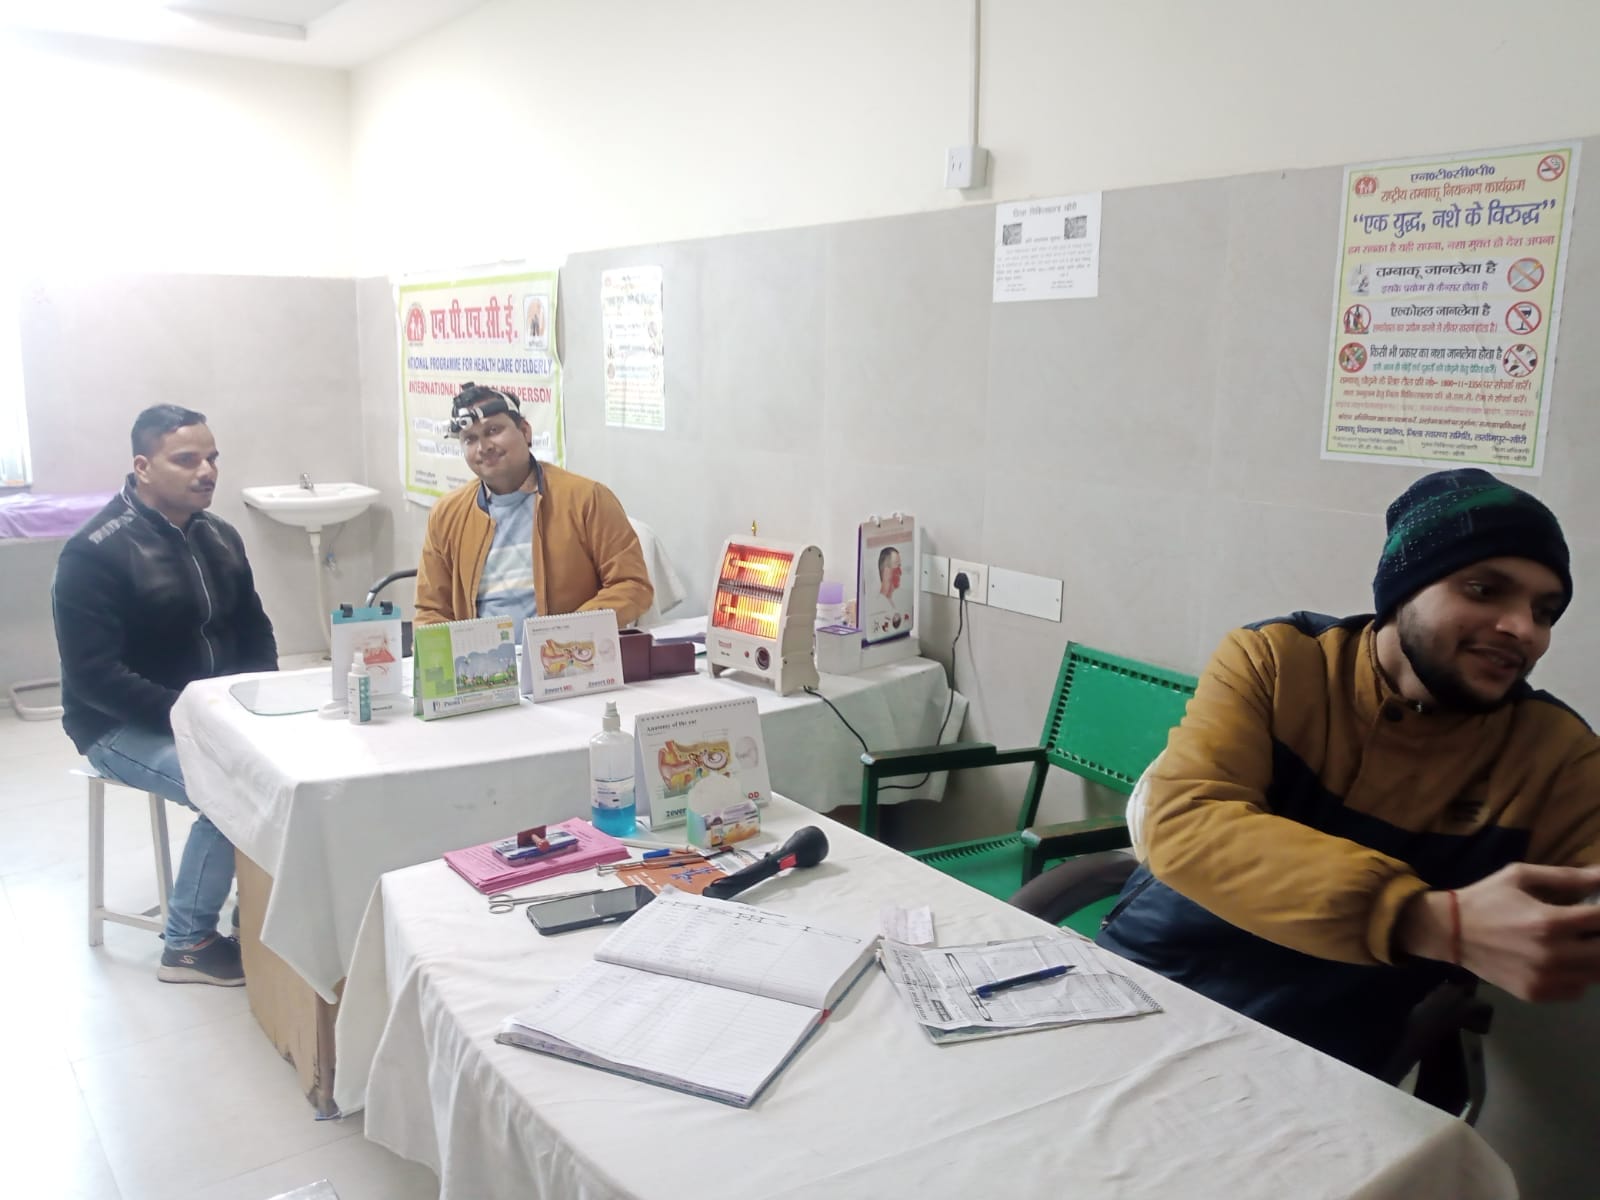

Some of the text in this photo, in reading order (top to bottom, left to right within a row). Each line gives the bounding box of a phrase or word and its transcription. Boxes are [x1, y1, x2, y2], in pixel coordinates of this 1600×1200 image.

[1485, 176, 1526, 194] कार्यक्रम
[1432, 203, 1461, 228] नशे
[1465, 202, 1484, 226] के
[1376, 259, 1498, 280] तम्बाकू जानलेवा है
[1435, 301, 1478, 317] जानलेवा
[1481, 301, 1492, 317] है
[462, 357, 473, 371] FOR
[474, 357, 496, 373] HEALTH
[497, 358, 513, 374] CARE
[409, 380, 457, 396] INTERNATIONAL
[517, 387, 552, 403] PERSON
[748, 791, 760, 799] OD
[665, 808, 687, 818] zever
